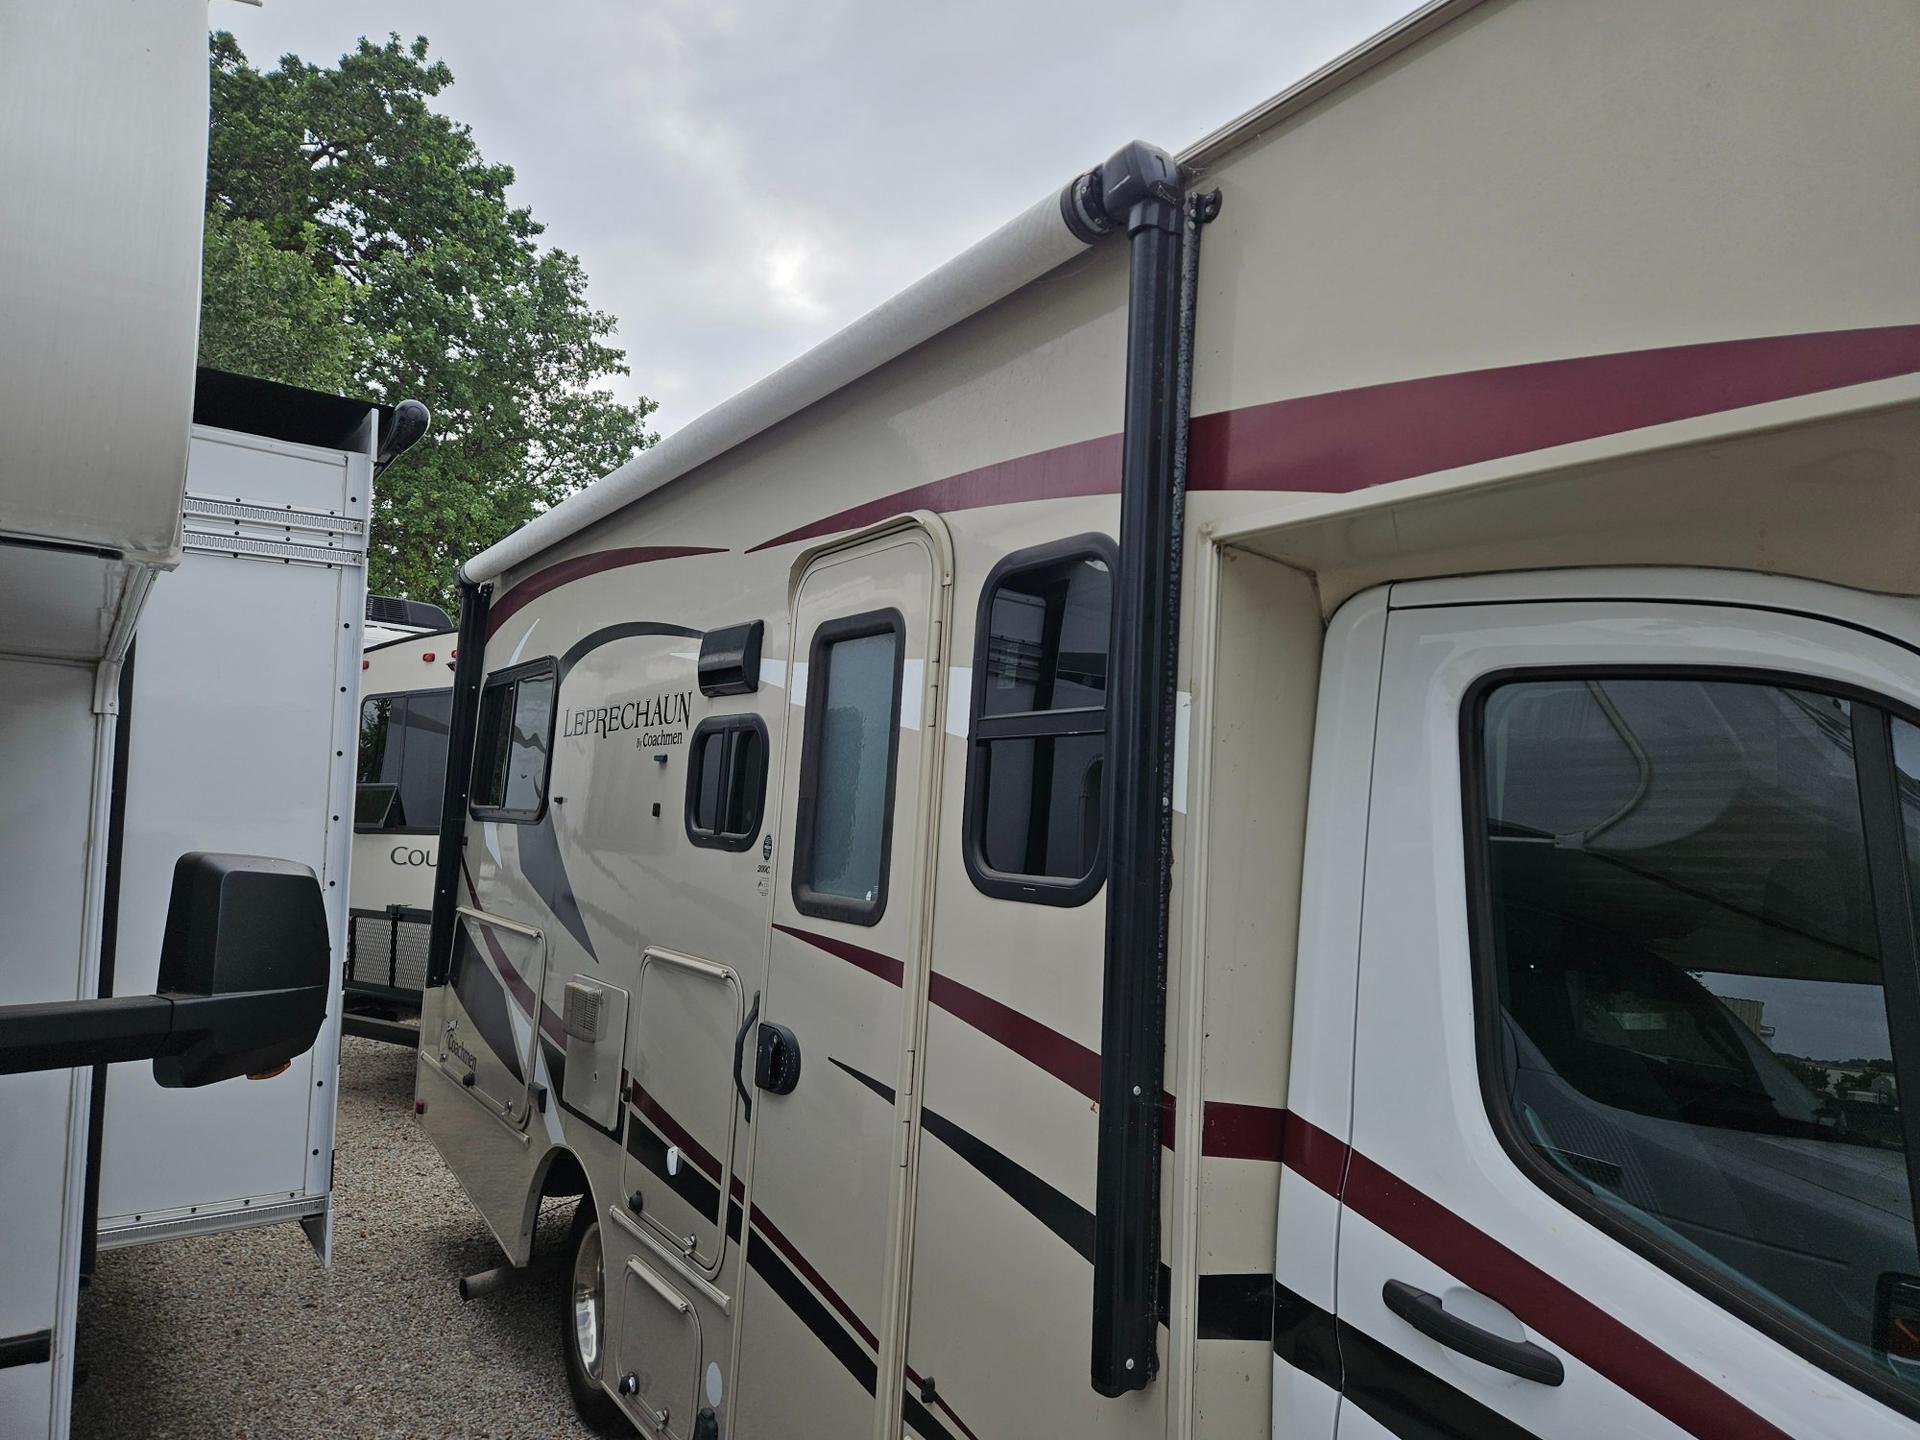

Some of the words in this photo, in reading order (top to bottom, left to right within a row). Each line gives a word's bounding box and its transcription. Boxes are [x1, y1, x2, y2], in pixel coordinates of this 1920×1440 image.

[563, 691, 692, 739] LEPRECHAUN
[642, 729, 683, 748] Coachmen
[447, 1032, 477, 1072] Coachmen
